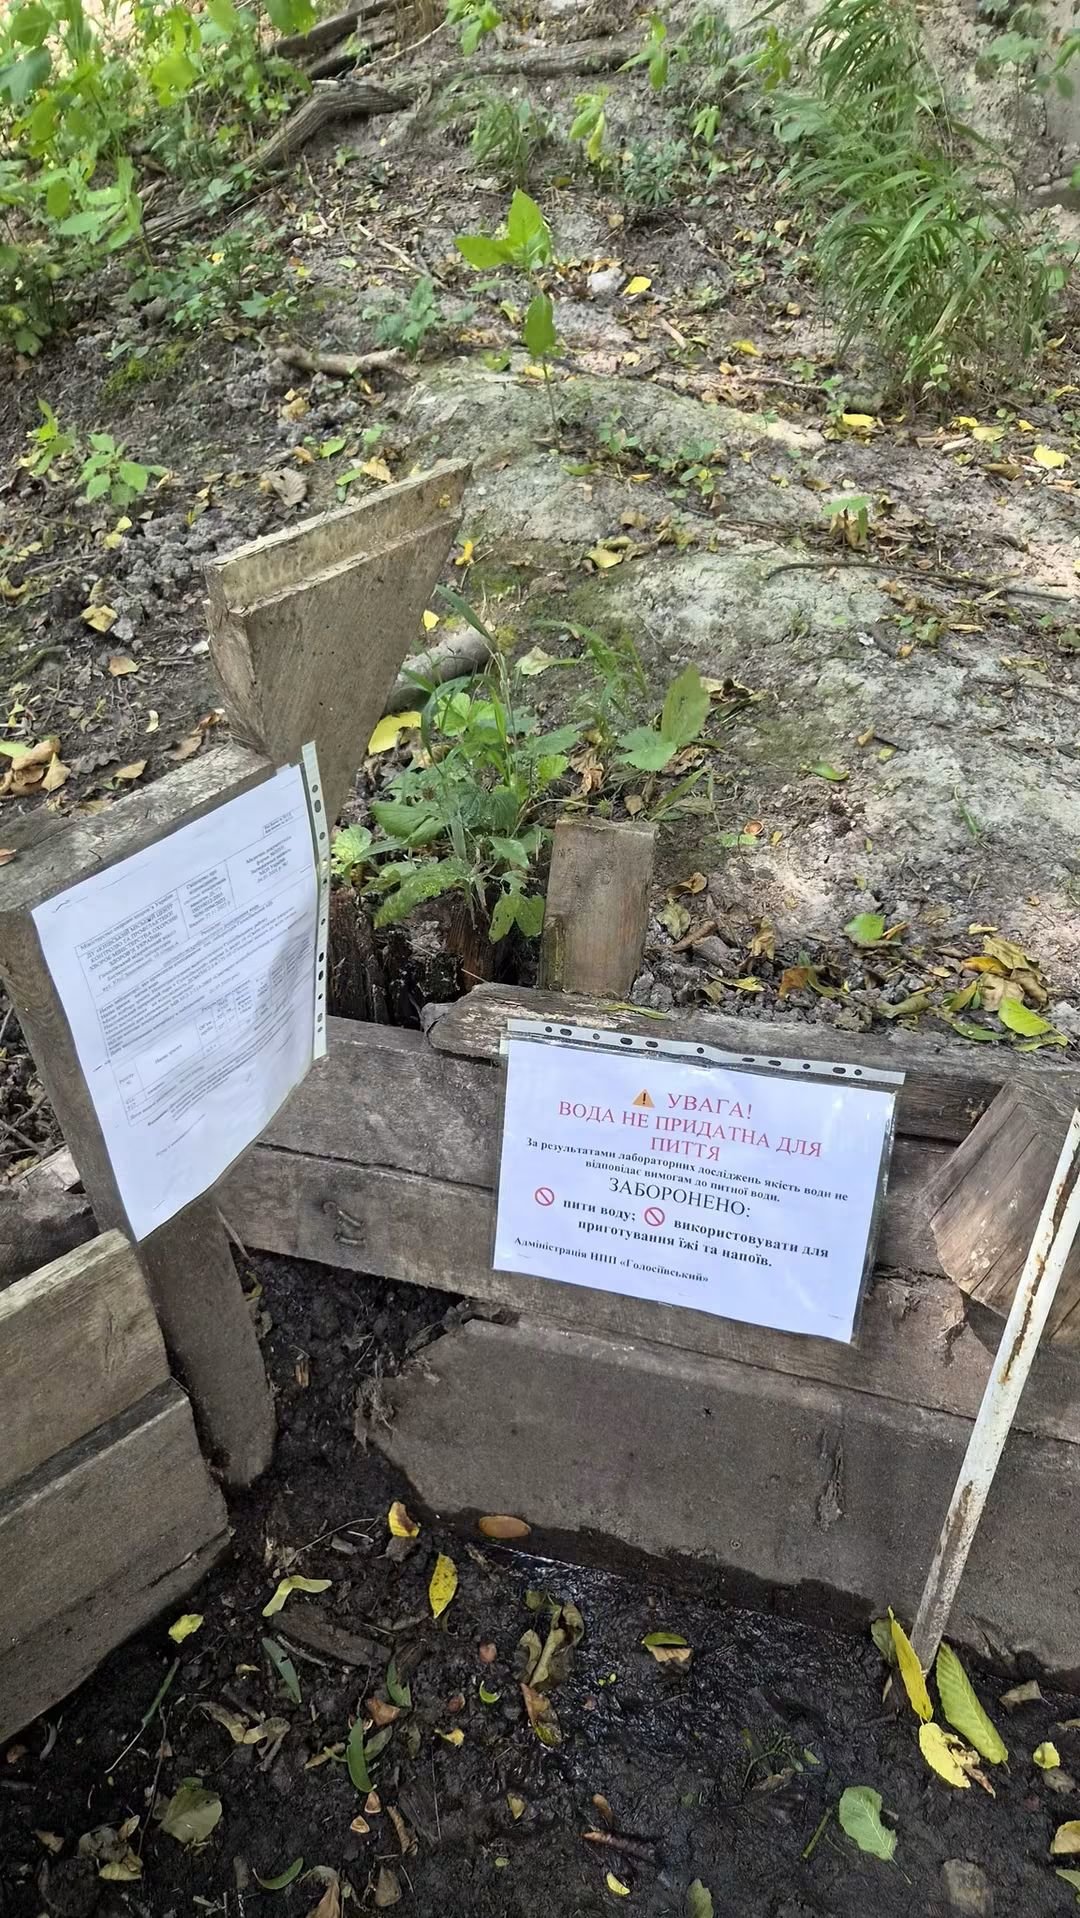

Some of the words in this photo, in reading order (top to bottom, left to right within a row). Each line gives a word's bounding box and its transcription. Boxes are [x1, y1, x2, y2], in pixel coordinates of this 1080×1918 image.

[668, 1093, 752, 1119] УВАГА!
[559, 1101, 615, 1123] ВОДА
[622, 1111, 649, 1128] НЕ
[655, 1115, 770, 1149] ПРИДАТНА
[776, 1137, 822, 1157] ДЛЯ
[651, 1137, 720, 1161] ПИТТЯ
[527, 1137, 538, 1147] За
[541, 1141, 616, 1159] результатами
[618, 1152, 696, 1172] лабораторних
[698, 1166, 762, 1185] досліджень
[764, 1179, 800, 1193] якість
[804, 1187, 831, 1199] води
[834, 1191, 848, 1201] не
[644, 1170, 692, 1185] вимогам
[694, 1178, 707, 1188] до
[710, 1181, 748, 1196] питної
[750, 1190, 780, 1202] води.
[609, 1177, 750, 1217] ЗАБОРОНЕНО:
[514, 1237, 587, 1259] Адміністрація
[563, 1200, 596, 1213] пити
[600, 1207, 636, 1221] воду;
[674, 1220, 798, 1253] використовувати
[802, 1245, 829, 1258] для
[578, 1221, 675, 1246] приготування
[678, 1237, 698, 1251] їжі
[702, 1244, 718, 1255] та
[722, 1249, 772, 1267] напоїв.
